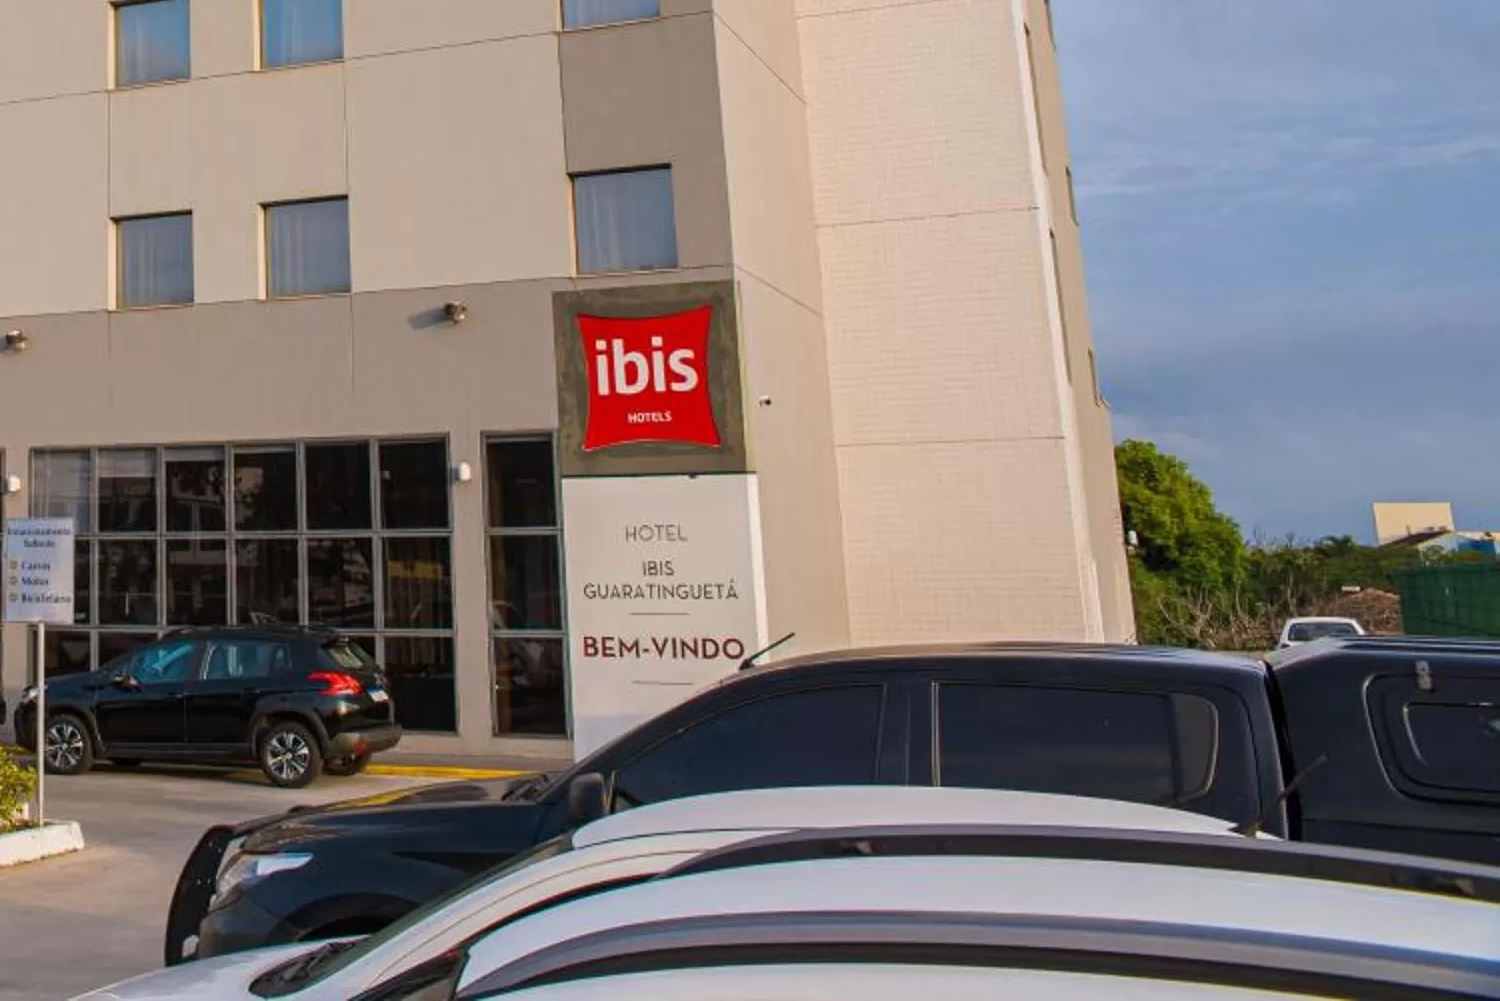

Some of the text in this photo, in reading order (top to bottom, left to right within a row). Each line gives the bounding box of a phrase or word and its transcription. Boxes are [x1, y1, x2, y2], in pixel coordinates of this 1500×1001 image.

[595, 336, 699, 396] ibis
[627, 410, 673, 424] HOTELS
[625, 524, 688, 543] HOTEL
[641, 561, 675, 577] IBIS
[583, 578, 739, 601] GUARATINGUETÁ
[583, 636, 745, 660] BEM-VINDO
